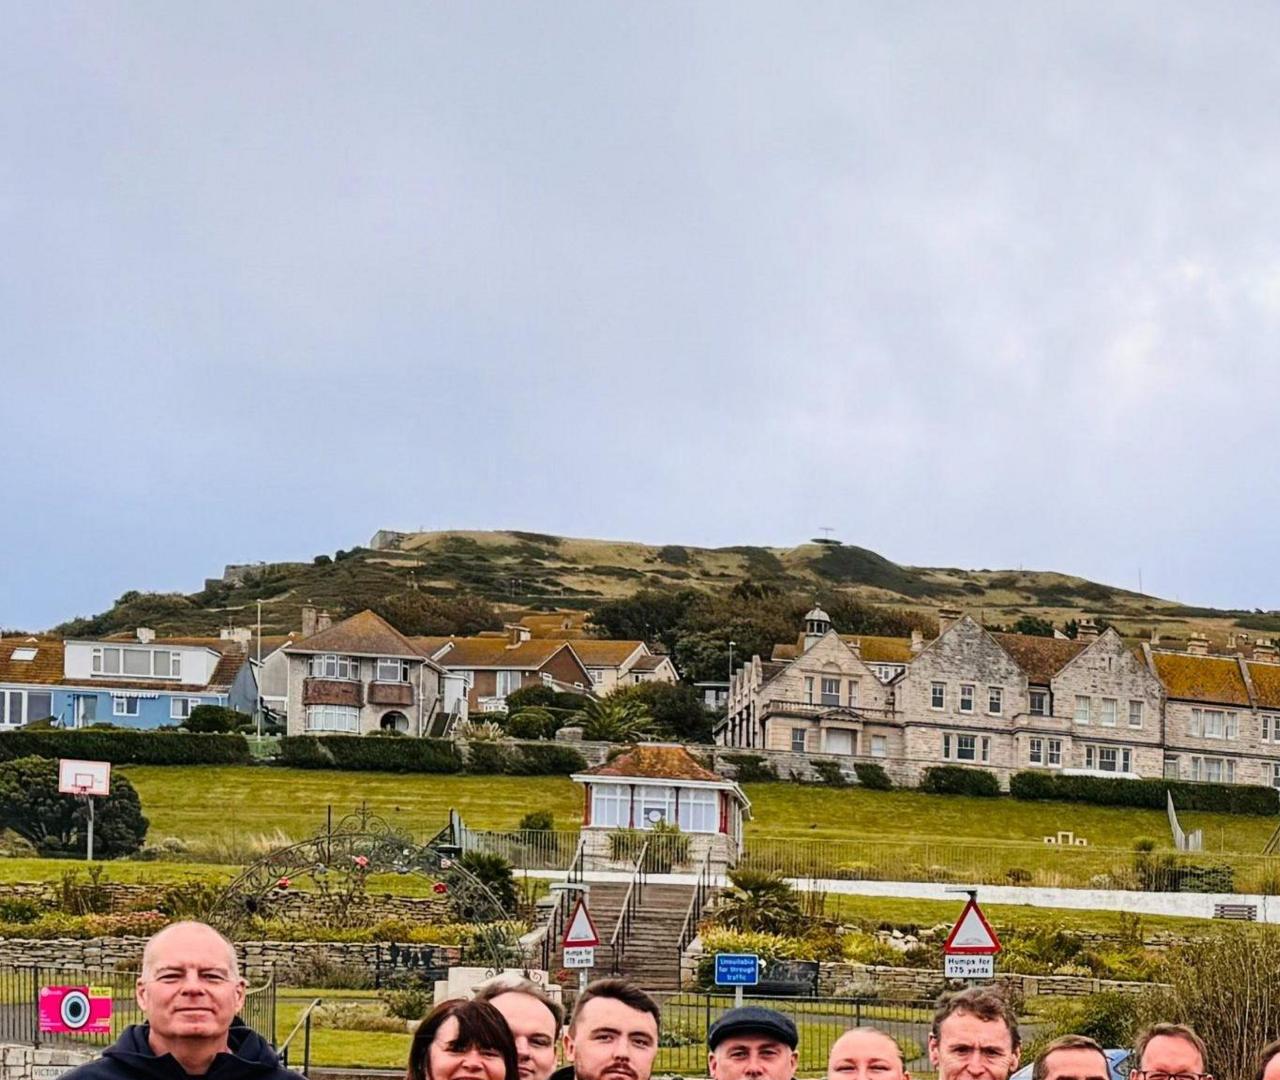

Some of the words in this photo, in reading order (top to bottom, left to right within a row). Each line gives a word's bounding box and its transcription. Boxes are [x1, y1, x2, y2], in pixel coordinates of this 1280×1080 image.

[948, 958, 975, 966] Humps
[730, 966, 755, 974] through
[950, 966, 964, 974] 175
[967, 966, 989, 975] yards
[34, 1067, 64, 1077] VICTORY
